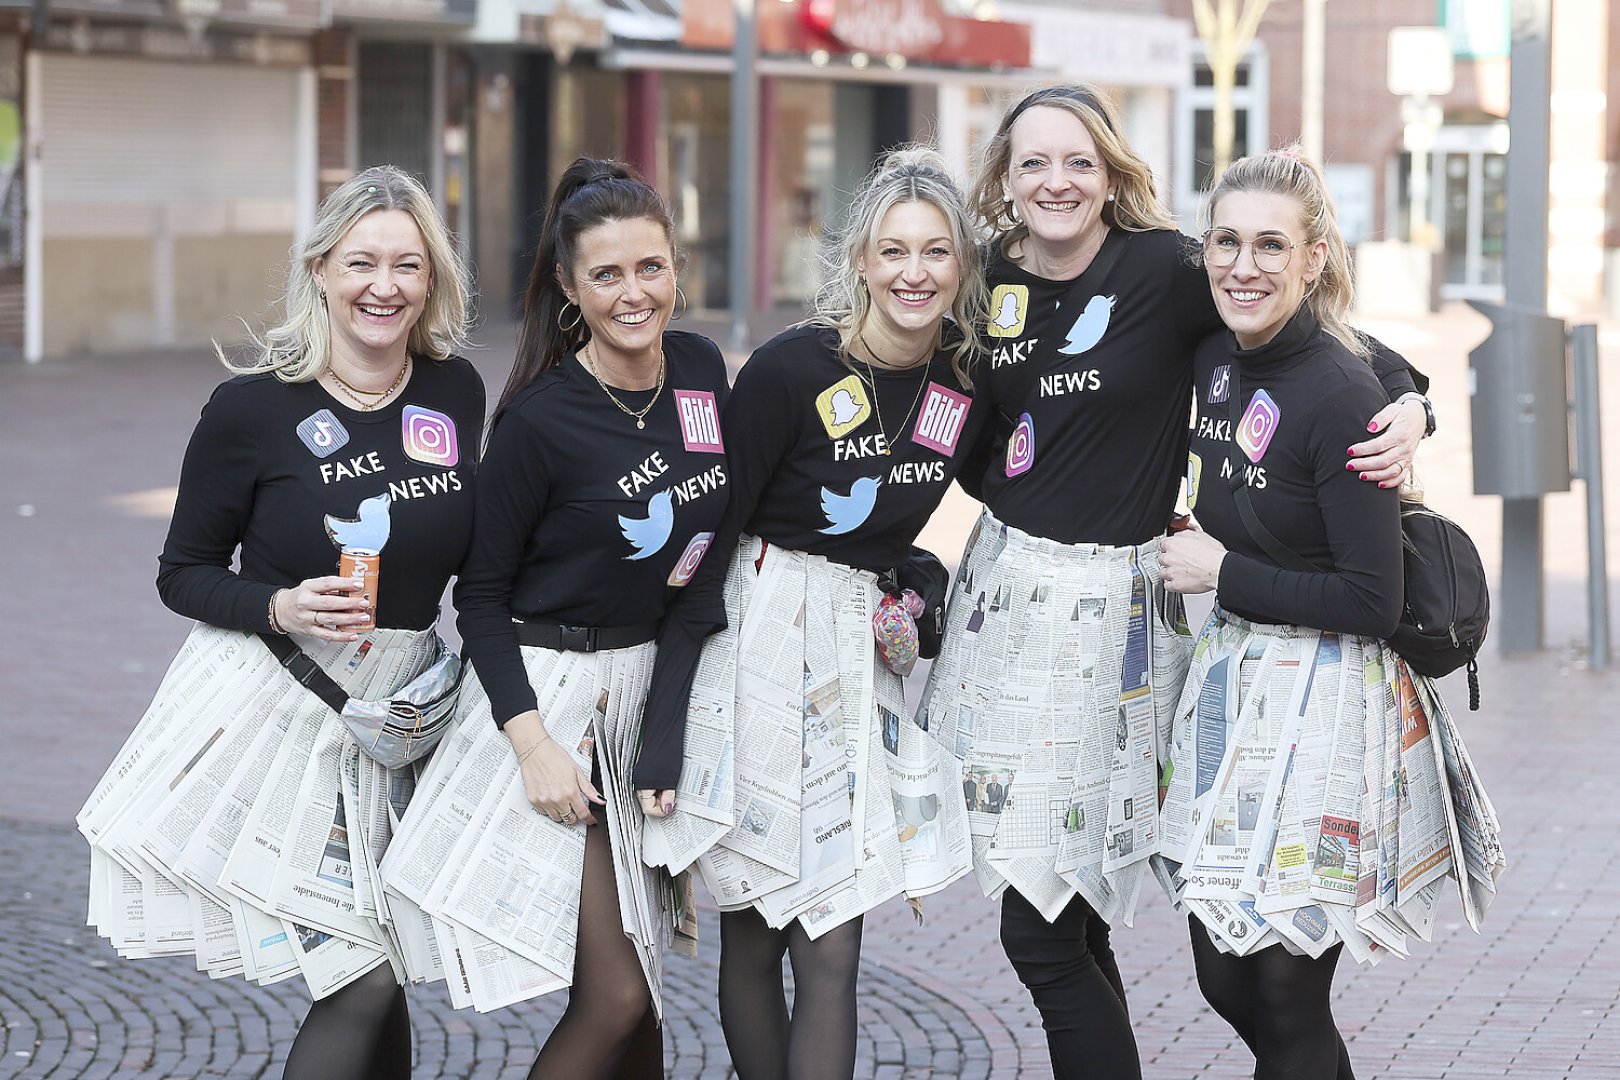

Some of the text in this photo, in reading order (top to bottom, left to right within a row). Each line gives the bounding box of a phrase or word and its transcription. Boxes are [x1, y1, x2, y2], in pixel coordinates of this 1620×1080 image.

[1039, 369, 1101, 398] NEWS
[679, 396, 720, 445] Bild
[917, 390, 966, 448] Bild
[834, 433, 887, 461] FAKE
[319, 450, 386, 485] FAKE
[617, 450, 670, 498] FAKE
[888, 460, 945, 485] NEWS
[1220, 457, 1267, 489] NWS
[388, 470, 462, 502] NEWS
[673, 464, 727, 506] NEWS
[738, 773, 751, 785] Vier
[750, 779, 788, 801] Kegelrobben
[805, 776, 825, 791] dem
[1087, 778, 1106, 790] Android
[449, 803, 466, 818] Nach
[255, 836, 267, 849] aus
[815, 818, 852, 844] RIESLAND
[293, 884, 355, 913] die Innenstädte
